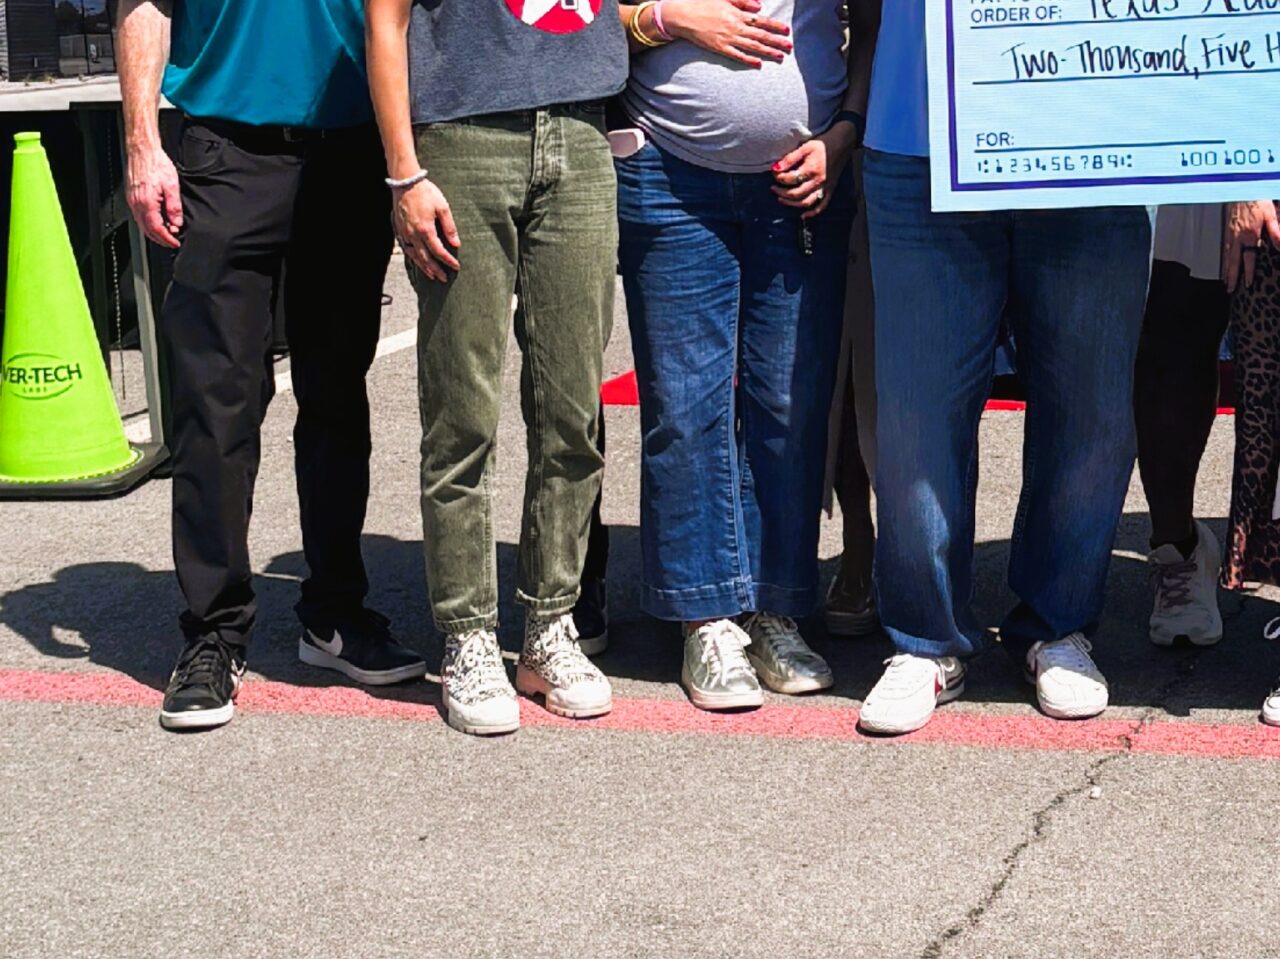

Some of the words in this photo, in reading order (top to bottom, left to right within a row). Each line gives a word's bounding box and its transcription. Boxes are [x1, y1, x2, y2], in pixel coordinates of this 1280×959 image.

[970, 7, 1030, 24] ORDER
[1034, 5, 1062, 20] OF:
[1202, 32, 1256, 70] Five
[975, 131, 1015, 147] FOR:
[2, 362, 83, 384] VER-TECH
